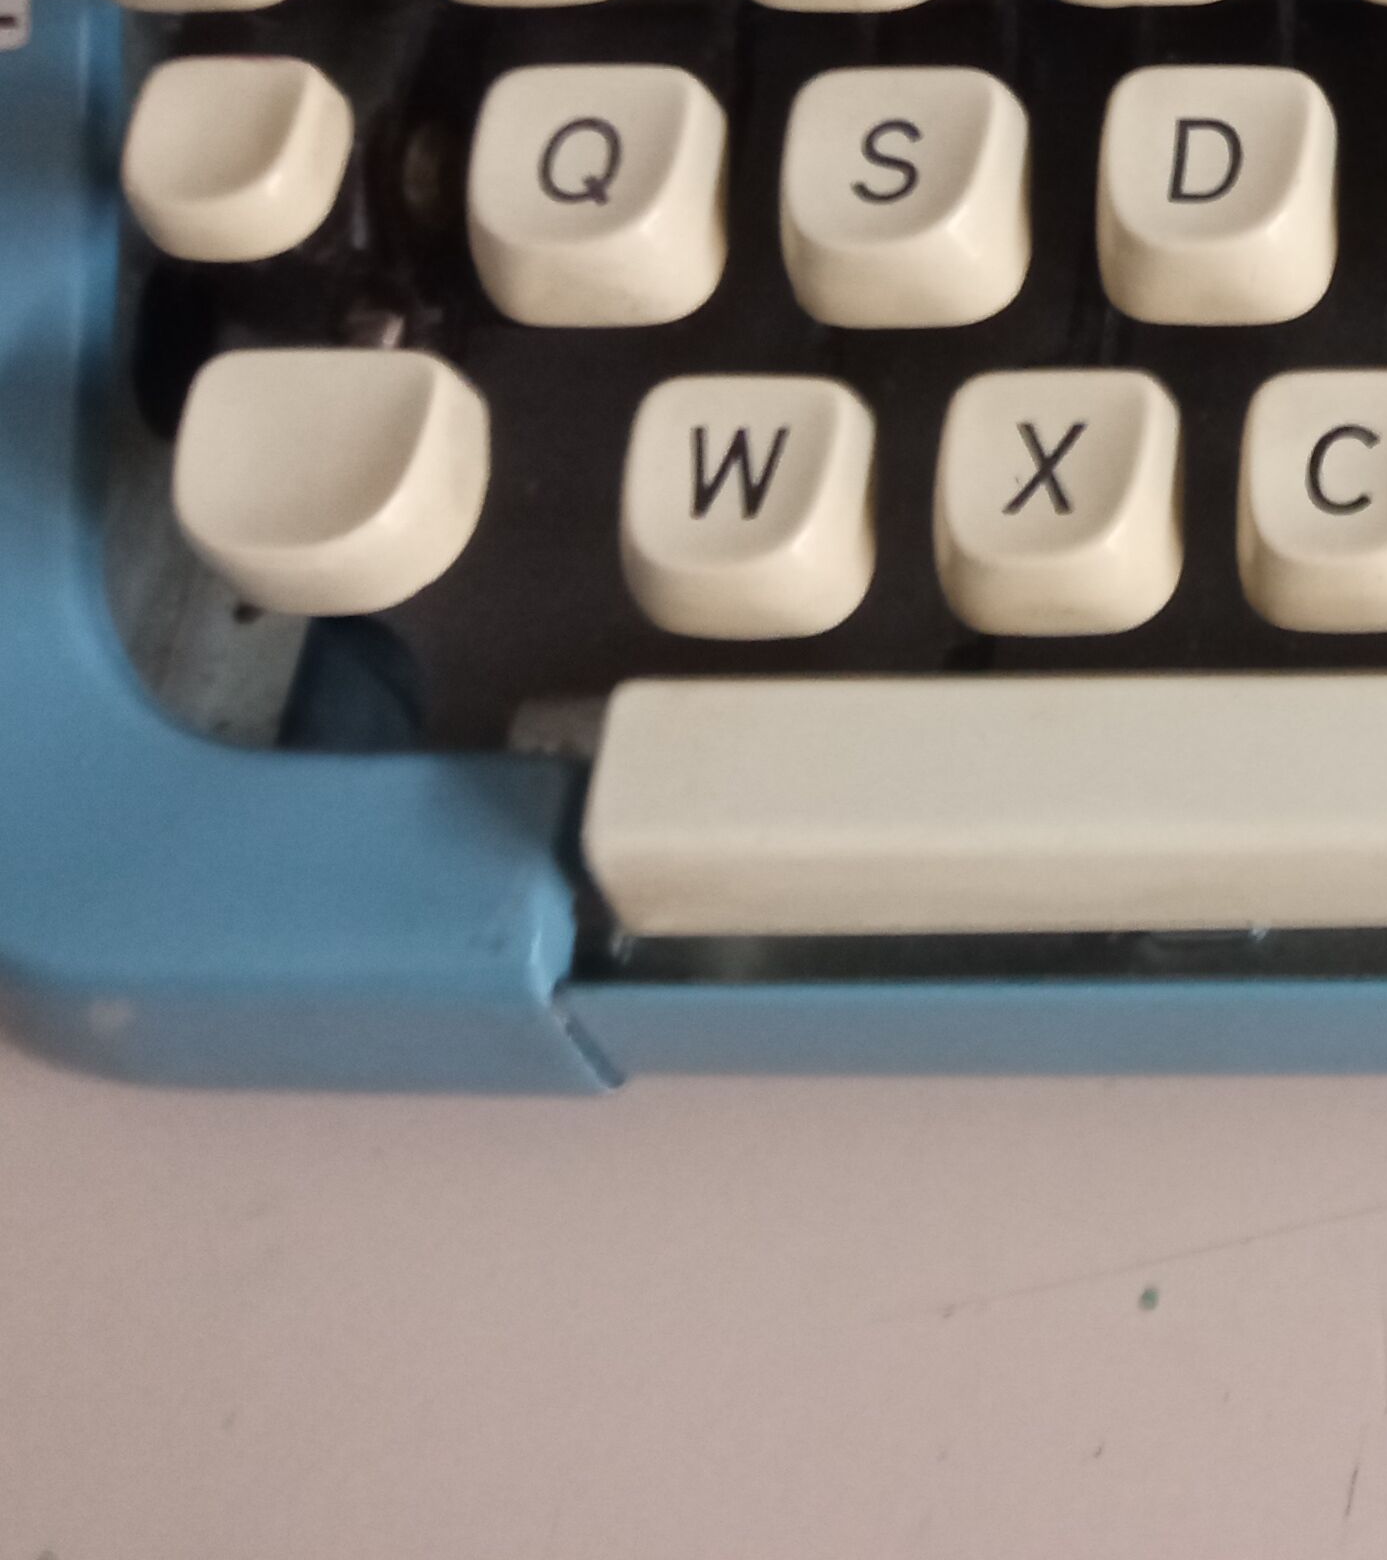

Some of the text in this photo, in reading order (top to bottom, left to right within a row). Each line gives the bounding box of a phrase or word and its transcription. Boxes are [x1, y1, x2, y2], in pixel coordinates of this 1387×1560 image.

[537, 116, 623, 206] Q
[851, 118, 922, 205] S
[1167, 117, 1244, 204] D
[690, 425, 790, 520] W
[1002, 421, 1087, 515] X
[1305, 423, 1380, 516] C
